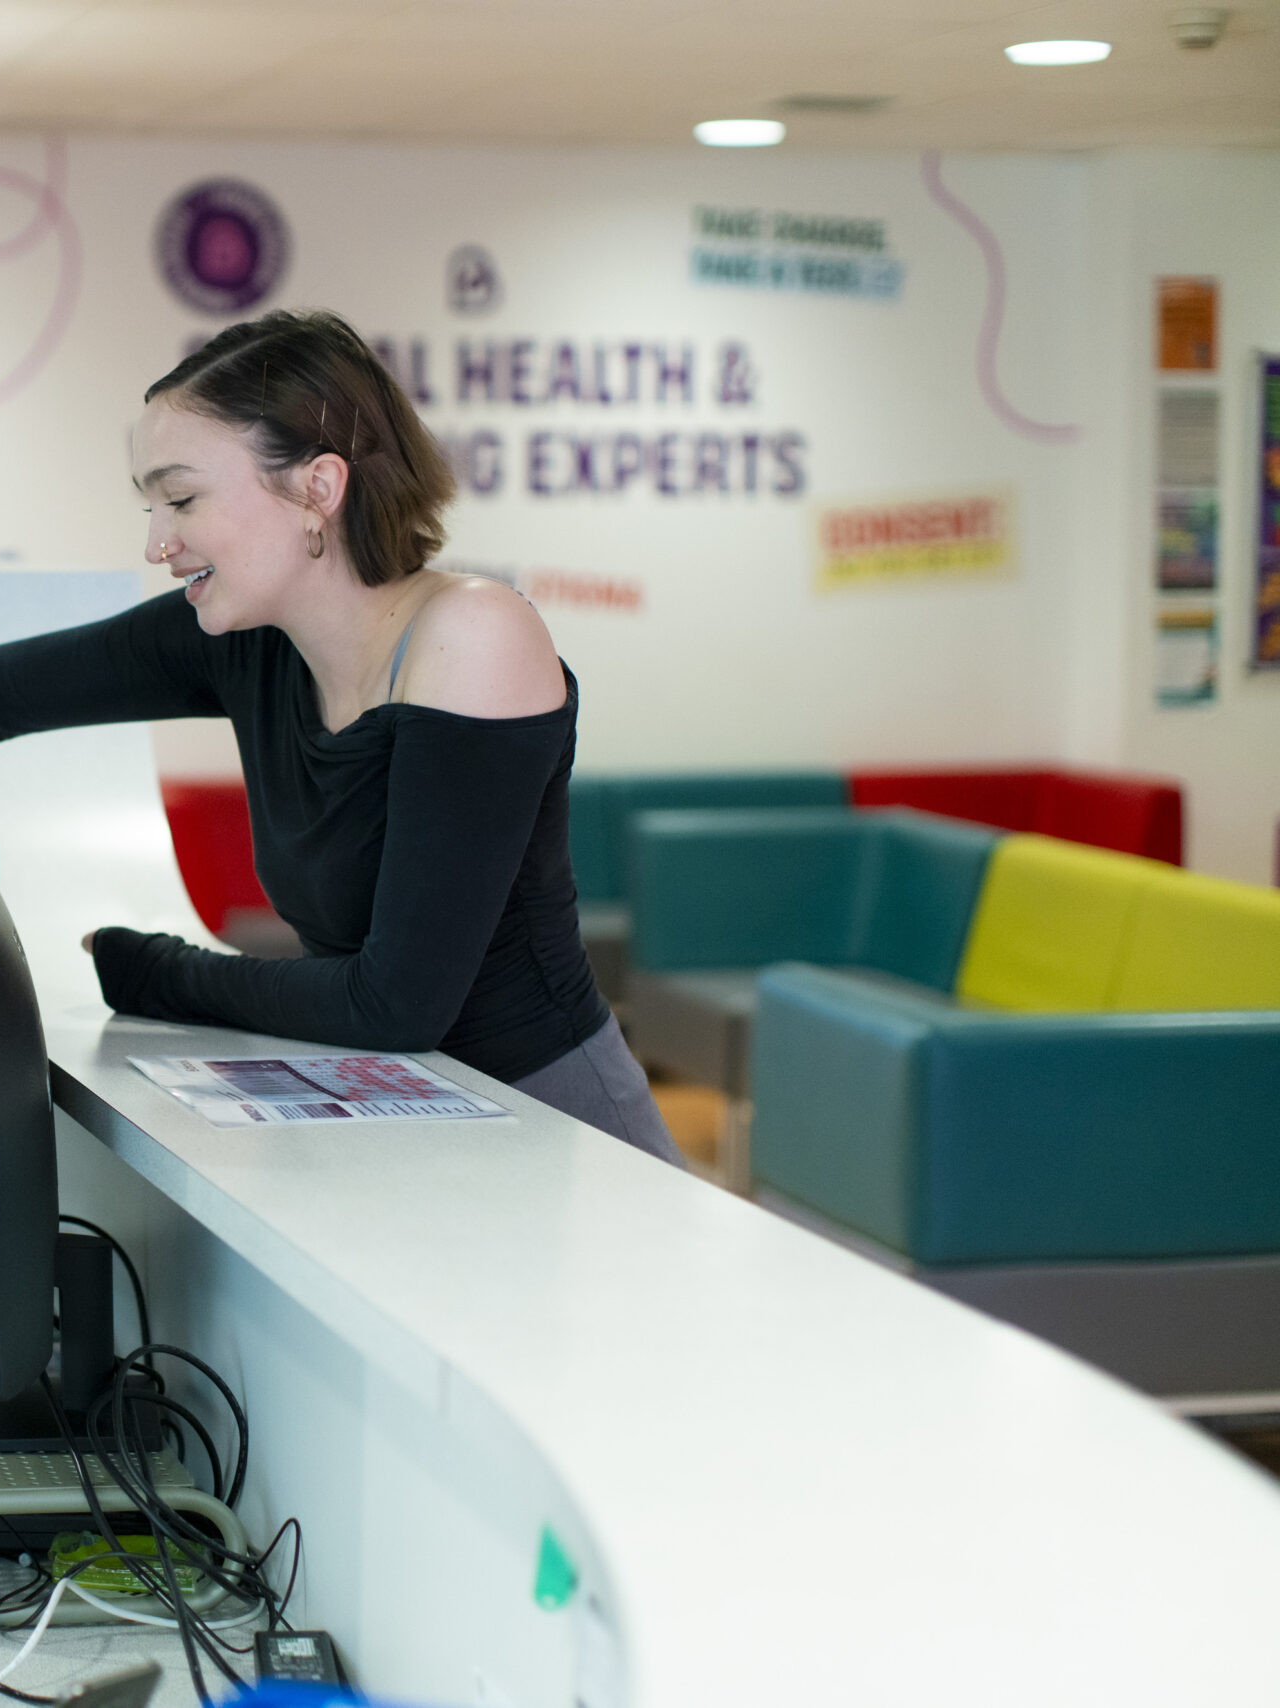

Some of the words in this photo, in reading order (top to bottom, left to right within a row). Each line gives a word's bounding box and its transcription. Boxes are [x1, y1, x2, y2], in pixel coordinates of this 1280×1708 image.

[456, 341, 693, 403] HEALTH
[718, 341, 755, 403] &
[529, 431, 808, 495] EXPERTS
